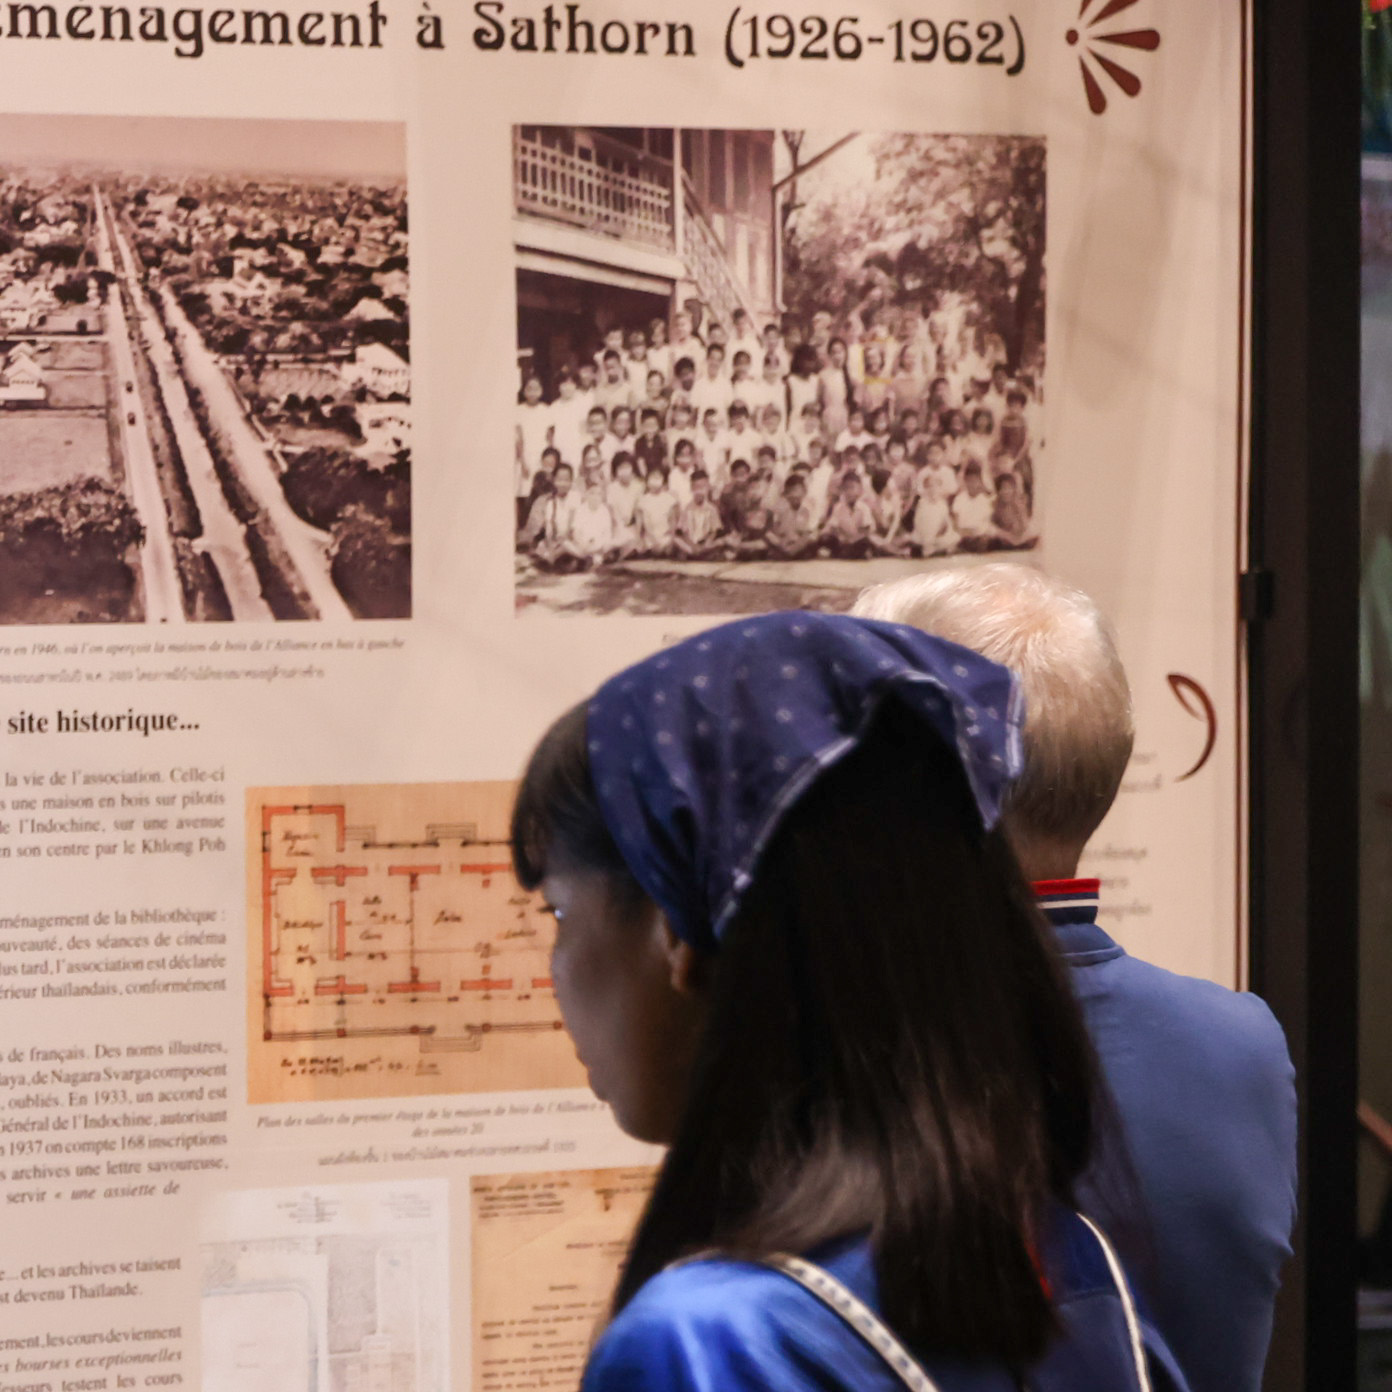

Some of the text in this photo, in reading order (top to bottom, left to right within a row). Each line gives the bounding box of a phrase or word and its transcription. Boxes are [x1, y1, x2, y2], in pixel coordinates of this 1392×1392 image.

[416, 0, 446, 49] à
[472, 1, 696, 55] Sathorn
[724, 5, 1026, 76] (1926-1962)
[7, 714, 49, 735] site
[4, 772, 19, 787] la
[22, 774, 45, 787] vie
[48, 771, 67, 786] de
[169, 767, 226, 783] Celle-ci
[10, 799, 38, 811] une
[42, 796, 95, 810] maison
[97, 797, 117, 808] en
[120, 792, 151, 808] bois
[155, 795, 178, 807] sur
[181, 790, 226, 810] pilotis
[112, 820, 136, 832] sur
[142, 820, 169, 831] une
[175, 818, 226, 830] avenue
[16, 845, 42, 857] son
[45, 842, 90, 856] centre
[95, 843, 118, 859] par
[123, 839, 135, 854] le
[141, 837, 194, 857] Khlong
[198, 836, 227, 852] Poh
[92, 911, 111, 926] de
[114, 910, 128, 926] la
[130, 908, 215, 929] bibliothèque
[66, 935, 92, 950] des
[95, 933, 151, 949] séances
[153, 932, 172, 947] de
[175, 930, 227, 947] cinéma
[7, 1048, 25, 1063] de
[13, 1286, 66, 1304] devenu
